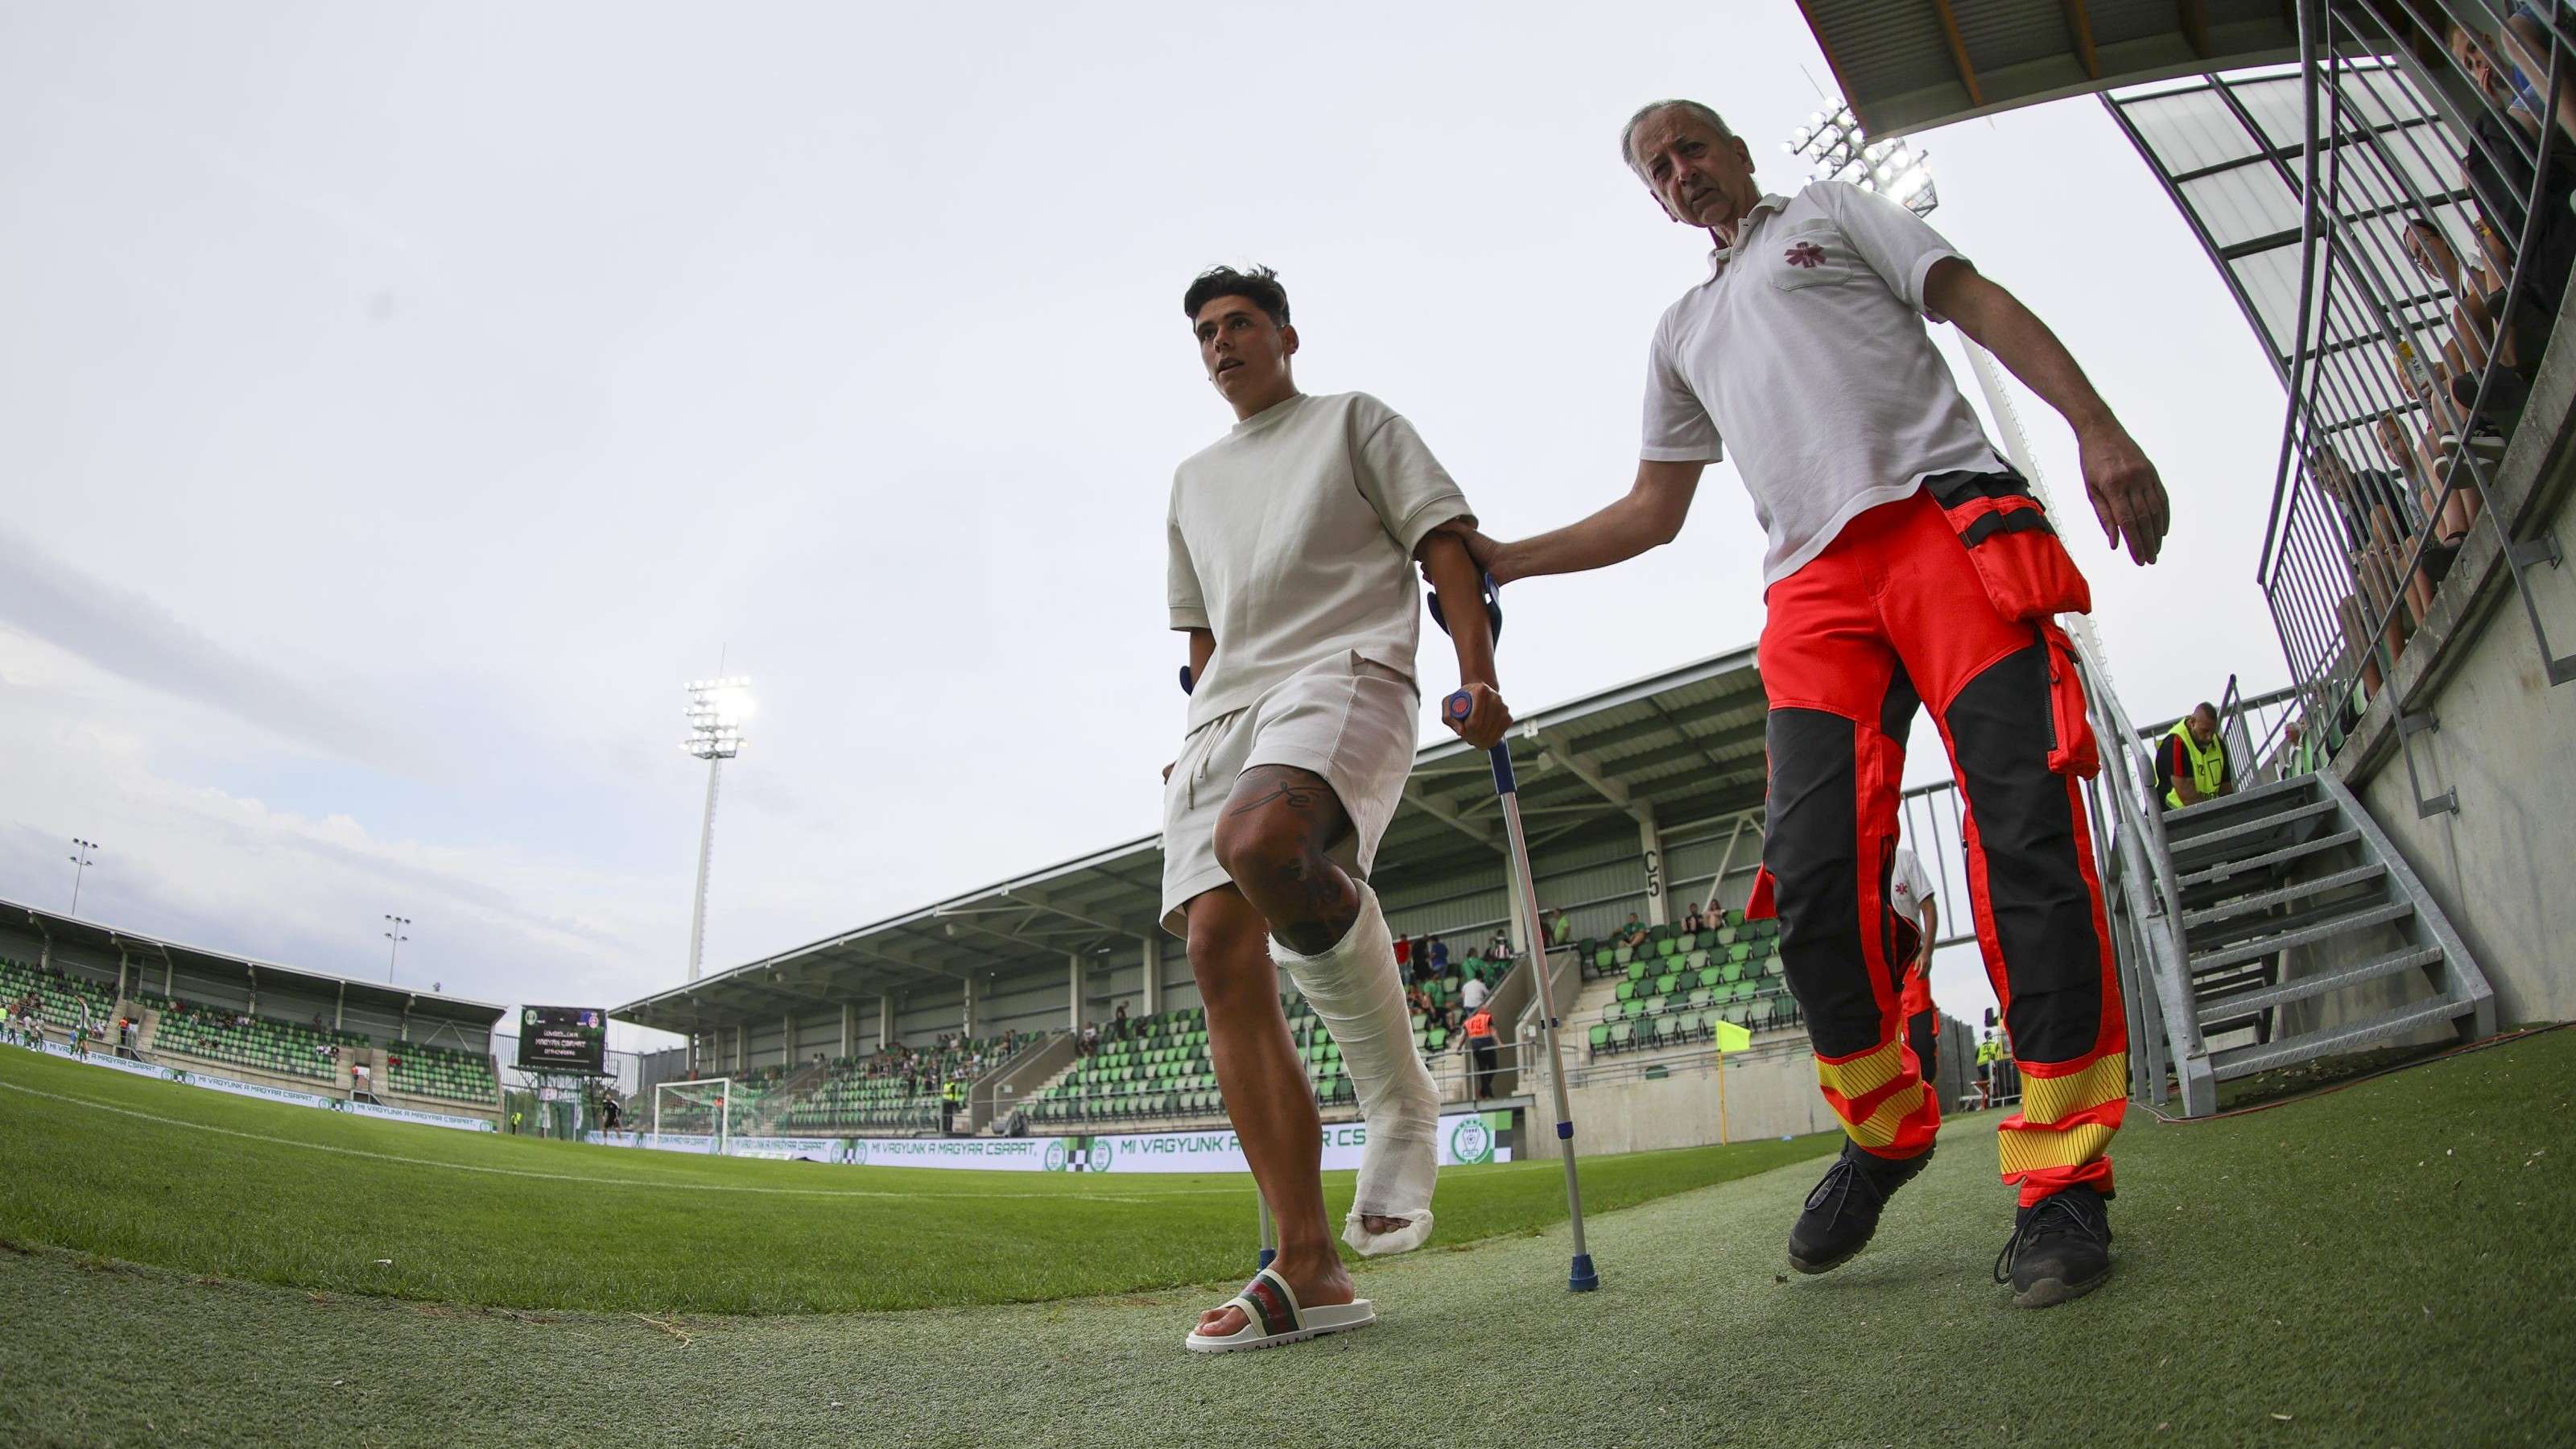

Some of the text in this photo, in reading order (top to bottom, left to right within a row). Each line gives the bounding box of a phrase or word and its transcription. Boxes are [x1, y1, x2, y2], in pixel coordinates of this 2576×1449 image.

[98, 1055, 126, 1067] MAGYAR
[208, 1077, 243, 1089] VAGYUNK
[250, 1085, 282, 1097] MAGYAR
[367, 1105, 402, 1116] VAGYUNK
[411, 1112, 443, 1121] MAGYAR
[872, 1142, 881, 1153] MI
[882, 1142, 926, 1154] VAGYUNK
[928, 1143, 935, 1152] A
[937, 1142, 983, 1155] MAGYAR
[1121, 1139, 1136, 1154] MI
[1141, 1136, 1224, 1154] VAGYUNK
